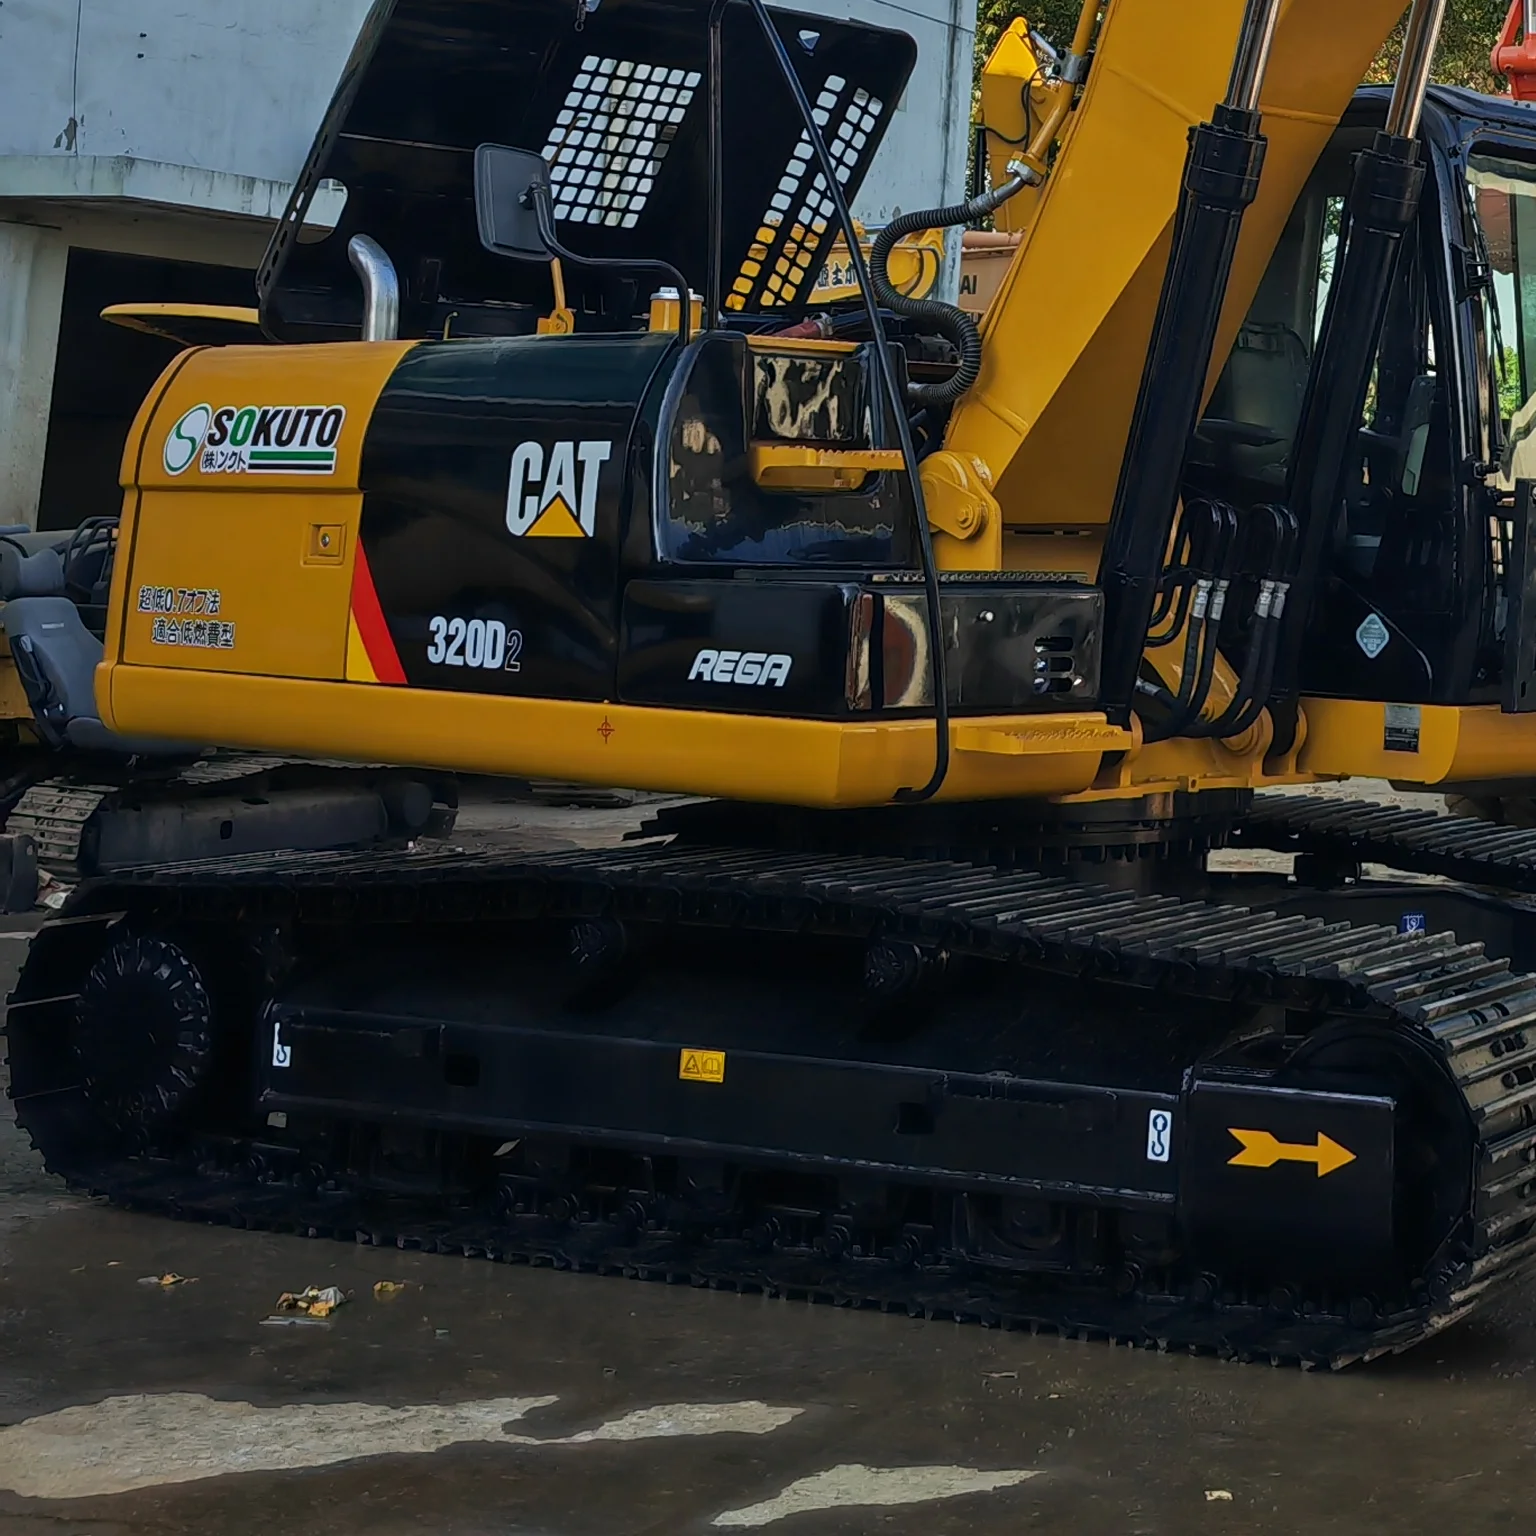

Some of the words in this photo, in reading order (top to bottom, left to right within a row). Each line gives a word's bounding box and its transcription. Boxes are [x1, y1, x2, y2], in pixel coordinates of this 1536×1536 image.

[206, 407, 344, 447] SOKUTO
[505, 440, 612, 538] CAT
[686, 649, 793, 687] REGA
